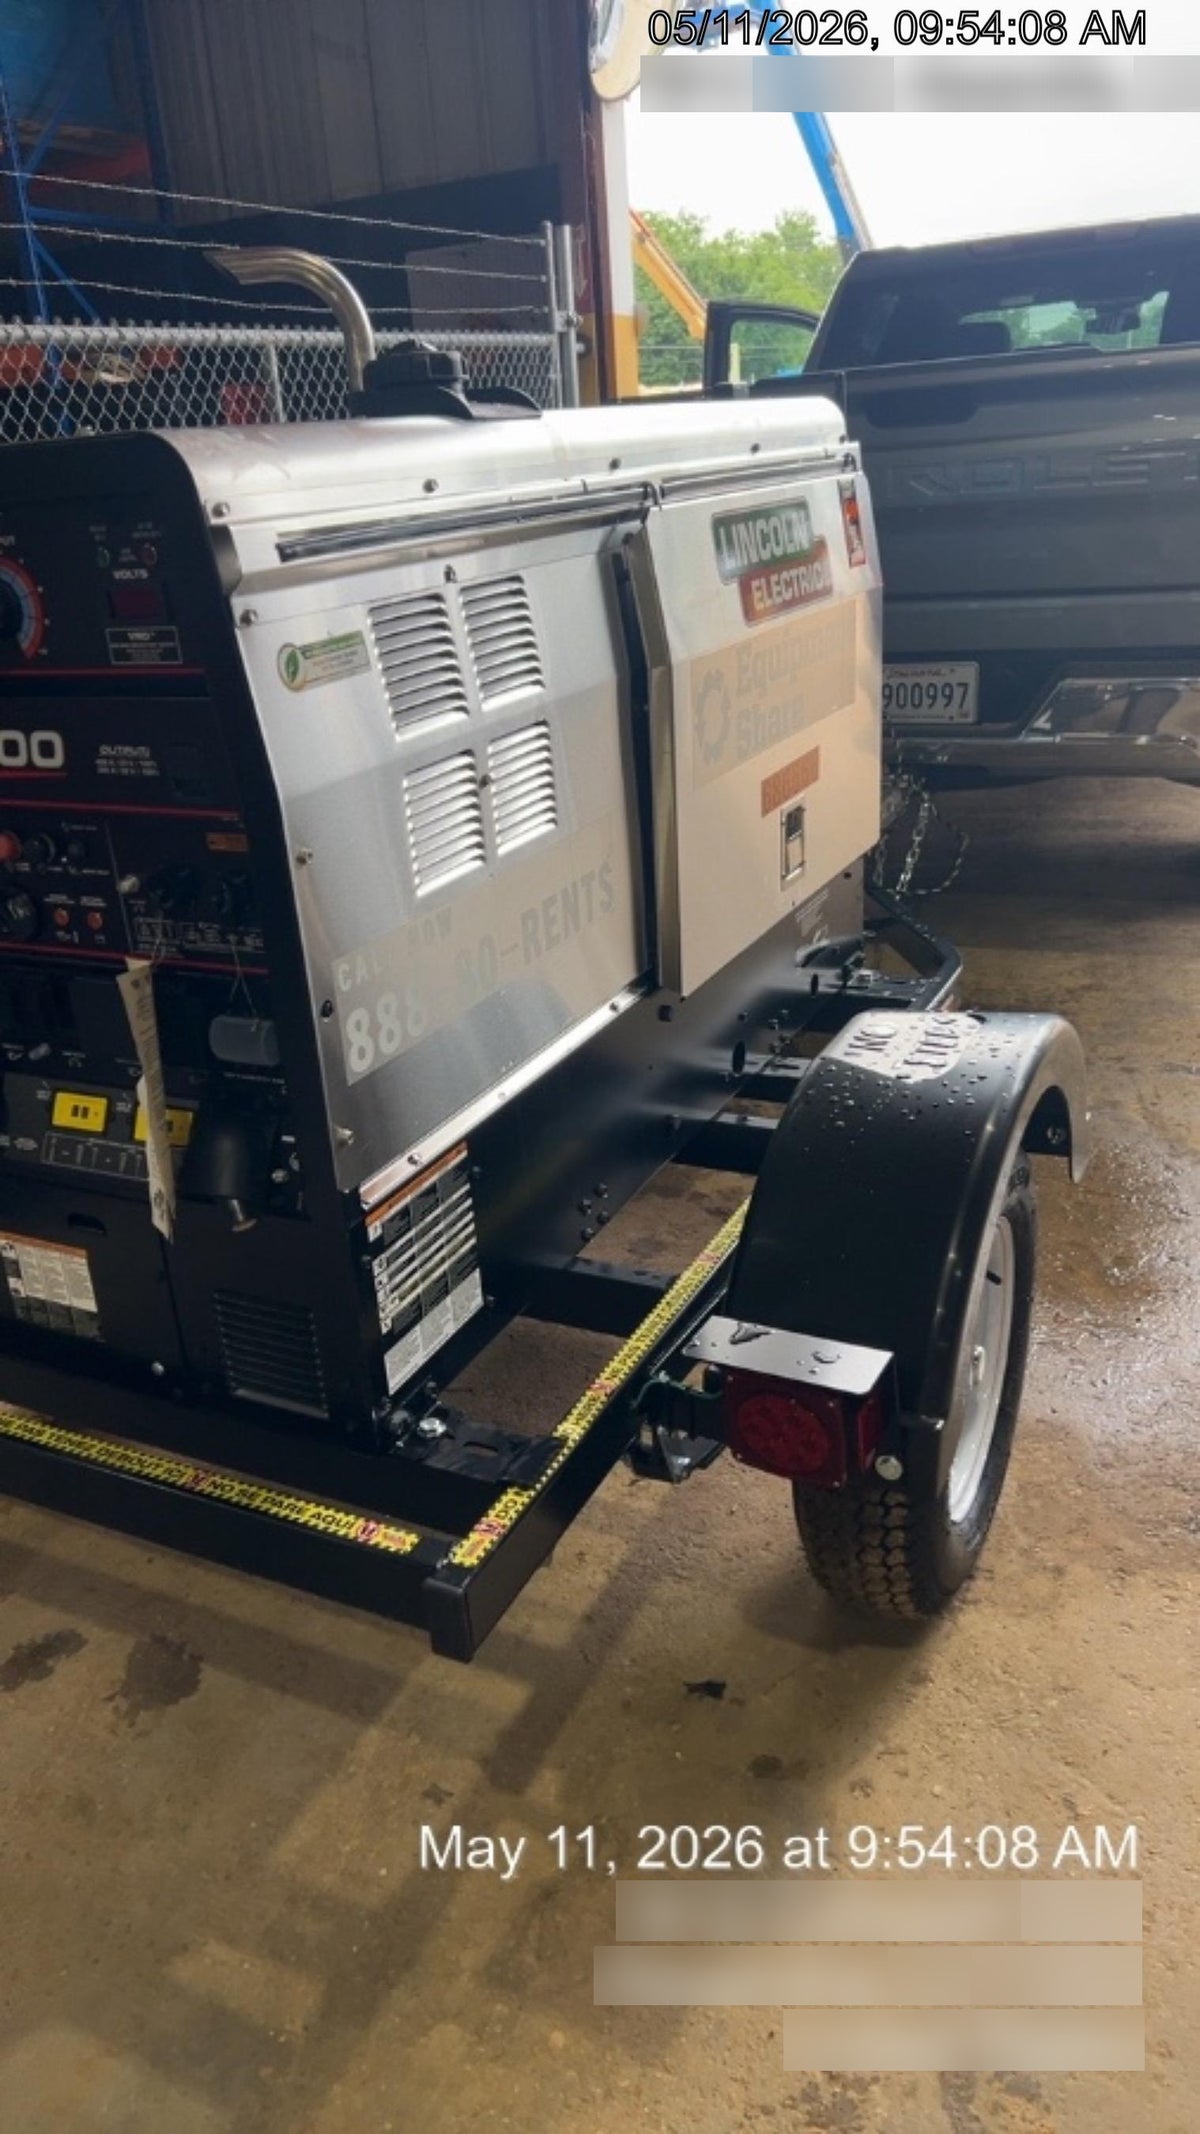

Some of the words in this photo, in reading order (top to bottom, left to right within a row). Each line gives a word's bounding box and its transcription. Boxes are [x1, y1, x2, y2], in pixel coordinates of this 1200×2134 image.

[719, 510, 810, 569] LINCOLN
[112, 568, 149, 579] VOLTS
[751, 558, 831, 611] ELECTRIC
[882, 682, 969, 710] 900997
[737, 694, 804, 759] Share
[208, 1479, 236, 1494] NO
[310, 1512, 356, 1529] AQUI
